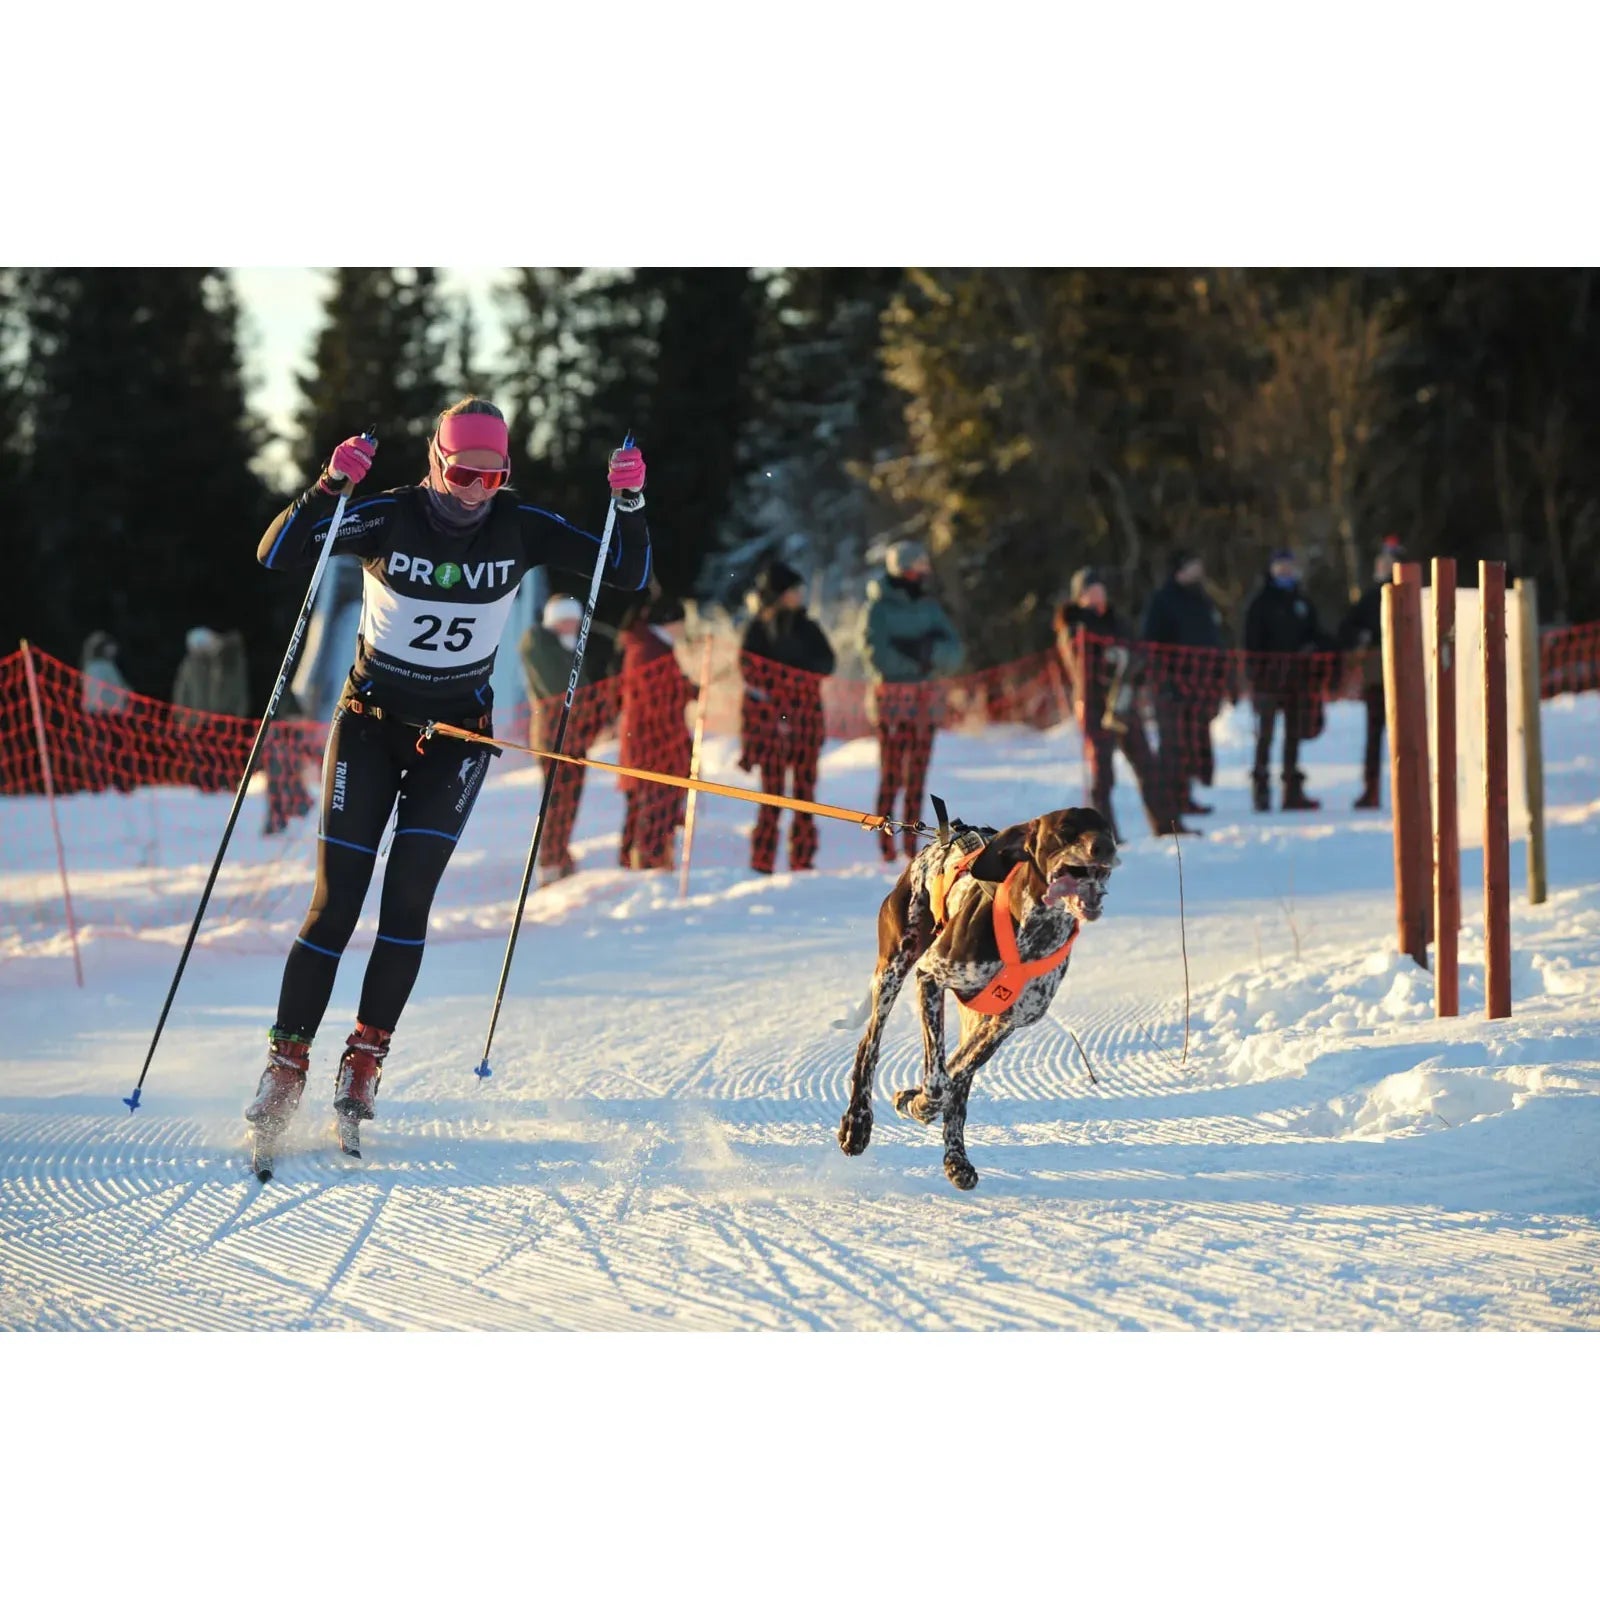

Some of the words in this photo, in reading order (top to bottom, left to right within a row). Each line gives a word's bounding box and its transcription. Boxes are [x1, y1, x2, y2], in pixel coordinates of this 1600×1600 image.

[387, 551, 516, 590] PROVIT
[408, 614, 477, 652] 25
[370, 657, 411, 677] Hundemat
[411, 672, 432, 681] med
[332, 761, 348, 811] TRIMTEX
